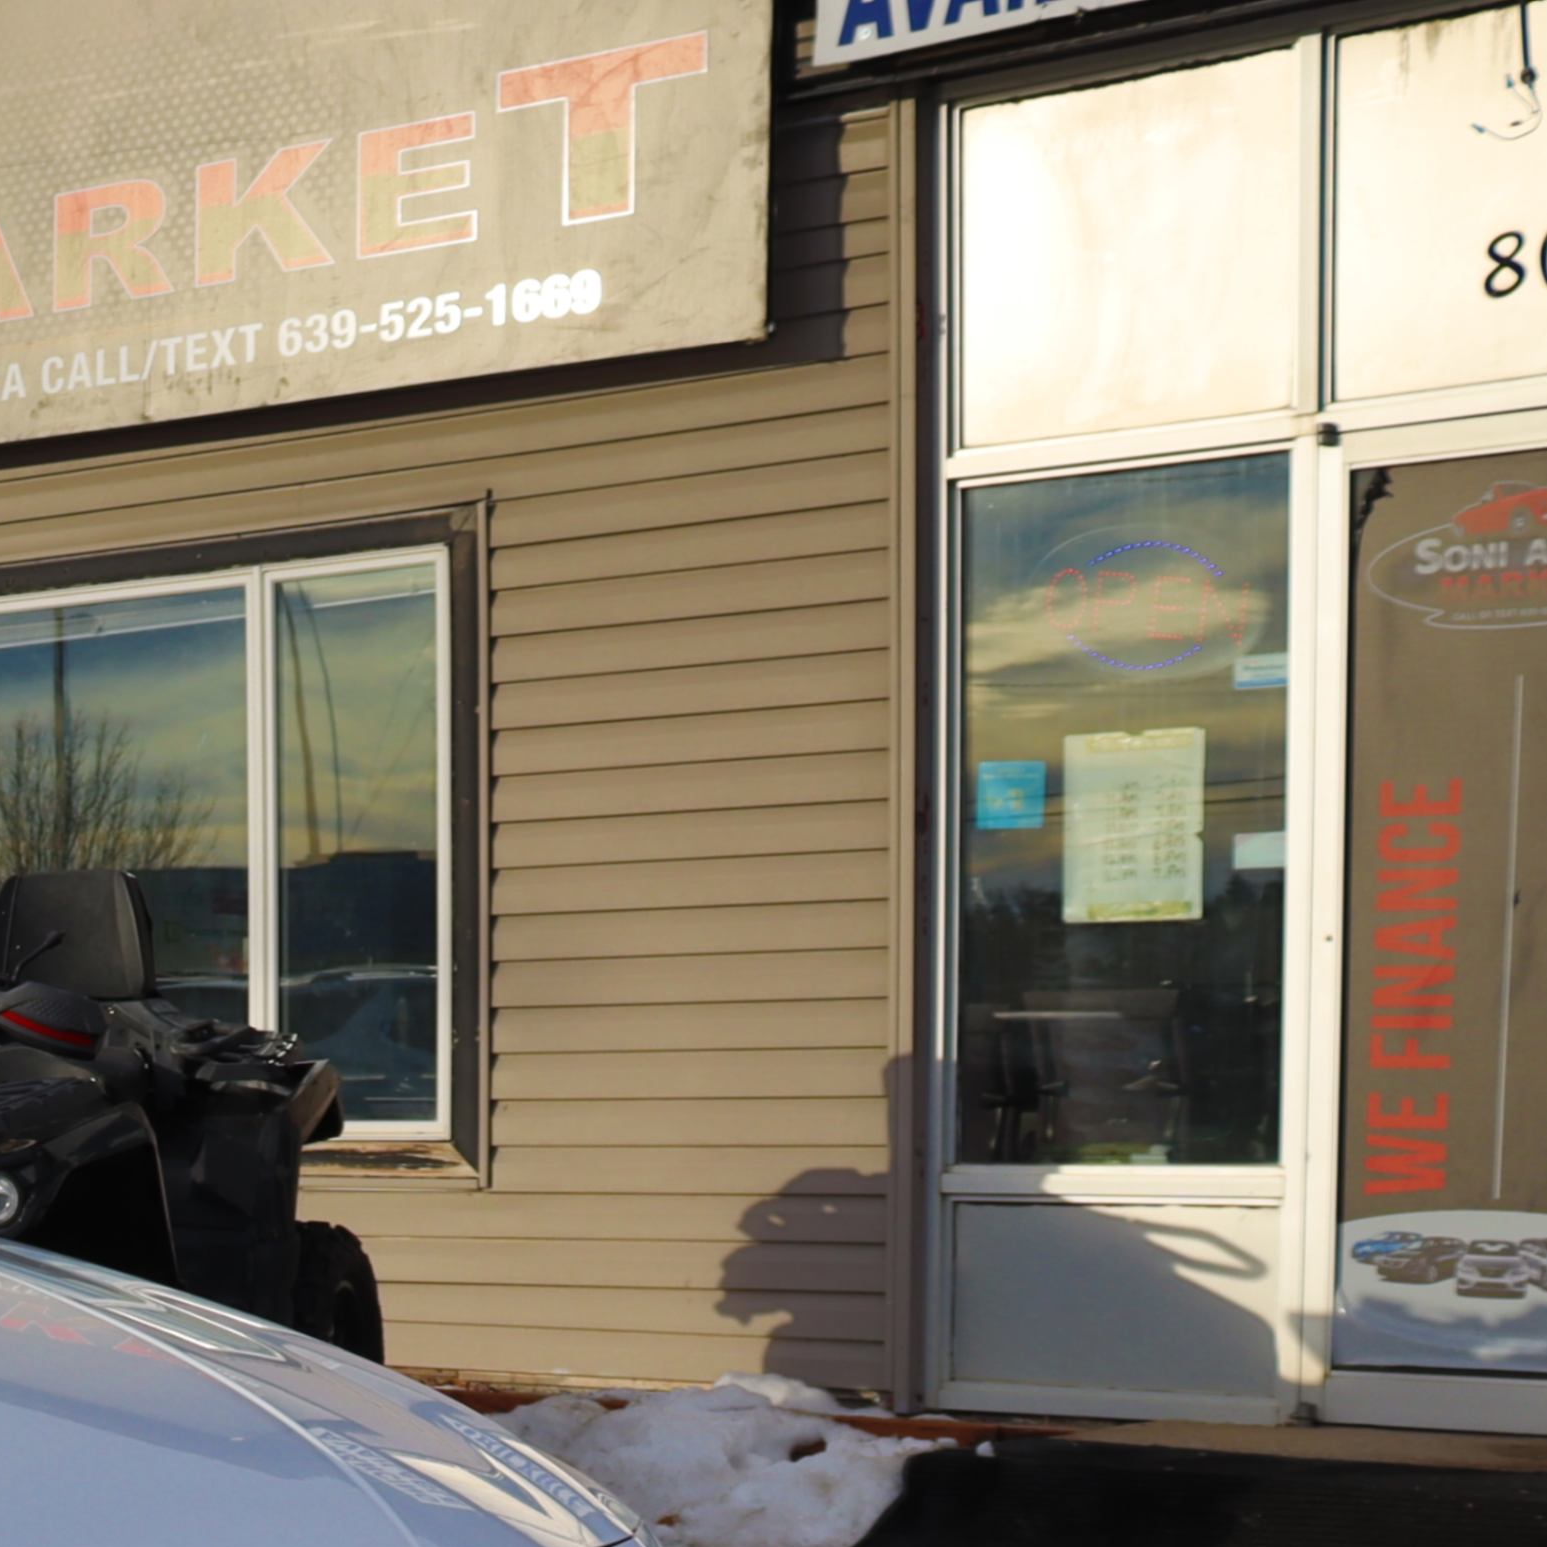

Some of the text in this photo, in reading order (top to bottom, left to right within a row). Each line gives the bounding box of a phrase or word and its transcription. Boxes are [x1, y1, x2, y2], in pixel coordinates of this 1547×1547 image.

[1485, 231, 1547, 298] 8
[41, 323, 264, 395] CALL/TEXT
[1044, 568, 1251, 647] OPEN
[1363, 777, 1463, 1196] WE FINANCE
